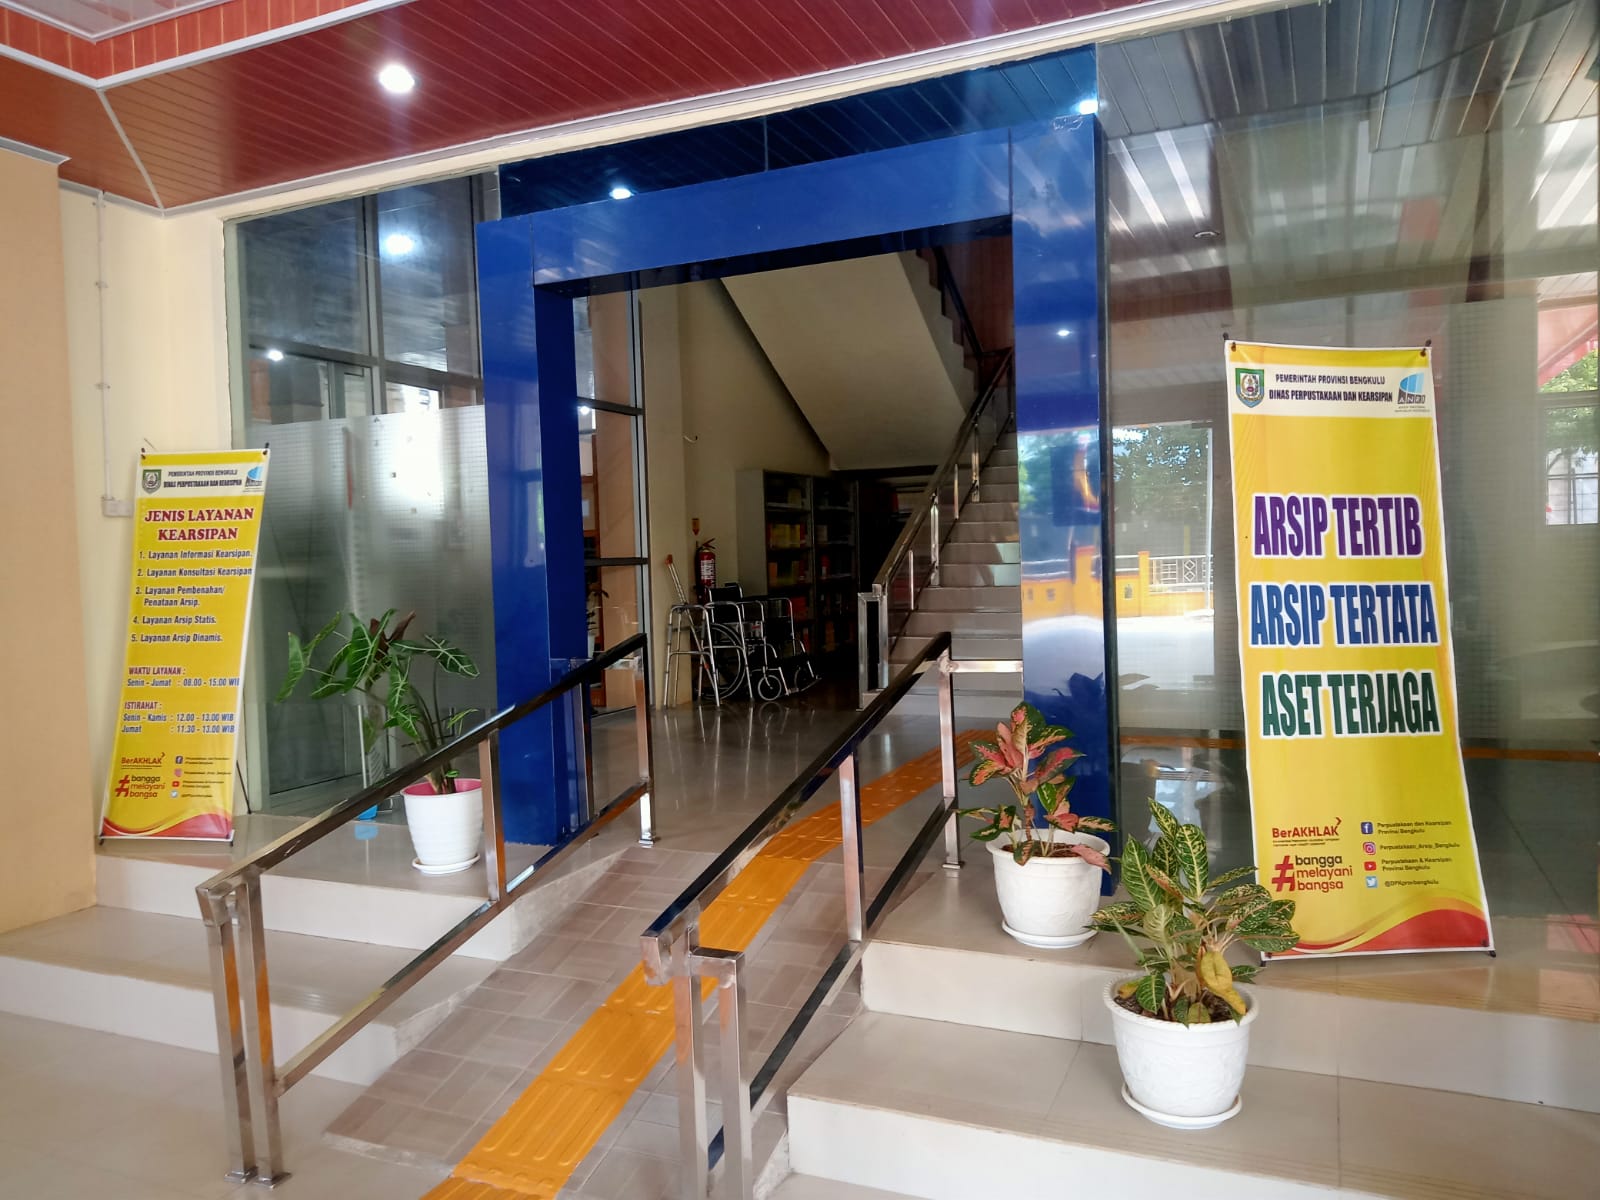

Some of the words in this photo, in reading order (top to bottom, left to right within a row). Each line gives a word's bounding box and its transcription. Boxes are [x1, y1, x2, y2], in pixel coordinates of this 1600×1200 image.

[1275, 374, 1316, 384] PEMERINTAH
[1318, 375, 1348, 384] PROVINSI
[1350, 376, 1386, 385] BENGKULU
[1269, 389, 1290, 400] DINAS
[1291, 390, 1342, 401] PERPUSTAKAAN
[1343, 391, 1356, 401] DAN
[1358, 392, 1393, 402] KEARSIPAN
[144, 510, 184, 522] JENIS
[188, 508, 254, 522] LAYANAN
[1253, 494, 1329, 557] ARSIP
[1331, 496, 1424, 557] TERTIB
[158, 528, 238, 541] KEARSIPAN
[139, 551, 145, 559] 1.
[148, 551, 178, 560] Layanan
[180, 550, 214, 558] Informasi
[137, 568, 144, 576] 2.
[146, 568, 176, 578] Layanan
[178, 568, 216, 576] Konsultasi
[136, 586, 142, 594] 3.
[145, 586, 175, 596] Layanan
[144, 598, 178, 606] Penataan
[180, 598, 200, 608] Arsip.
[1250, 582, 1326, 647] ARSIP
[1329, 583, 1439, 646] TERTATA
[132, 616, 140, 624] 4.
[142, 616, 172, 626] Layanan
[174, 616, 192, 625] Arsip
[194, 616, 216, 624] Statis.
[131, 634, 138, 642] 5.
[140, 634, 170, 644] Layanan
[172, 634, 190, 643] Arsip
[128, 666, 151, 675] WAKTU
[152, 666, 182, 675] LAYANAN
[127, 678, 144, 686] Senin
[151, 678, 172, 686] Jumat
[184, 678, 202, 686] 08.00
[209, 678, 226, 686] 15.00
[124, 702, 158, 710] ISTIRAHAT
[1261, 673, 1323, 738] ASET
[1326, 670, 1442, 736] TERJAGA
[124, 714, 140, 722] Senin
[148, 714, 167, 722] Kamis
[176, 714, 194, 722] 12.00
[202, 714, 220, 722] 13.00
[120, 757, 162, 765] BerAKHLAK
[131, 775, 160, 784] bangga
[130, 782, 166, 791] melayani
[130, 790, 158, 799] bangsa
[1272, 826, 1339, 838] BerAKHLAK
[1295, 855, 1343, 868] bangga
[1296, 865, 1353, 880] melayani
[1297, 880, 1344, 893] bangsa
